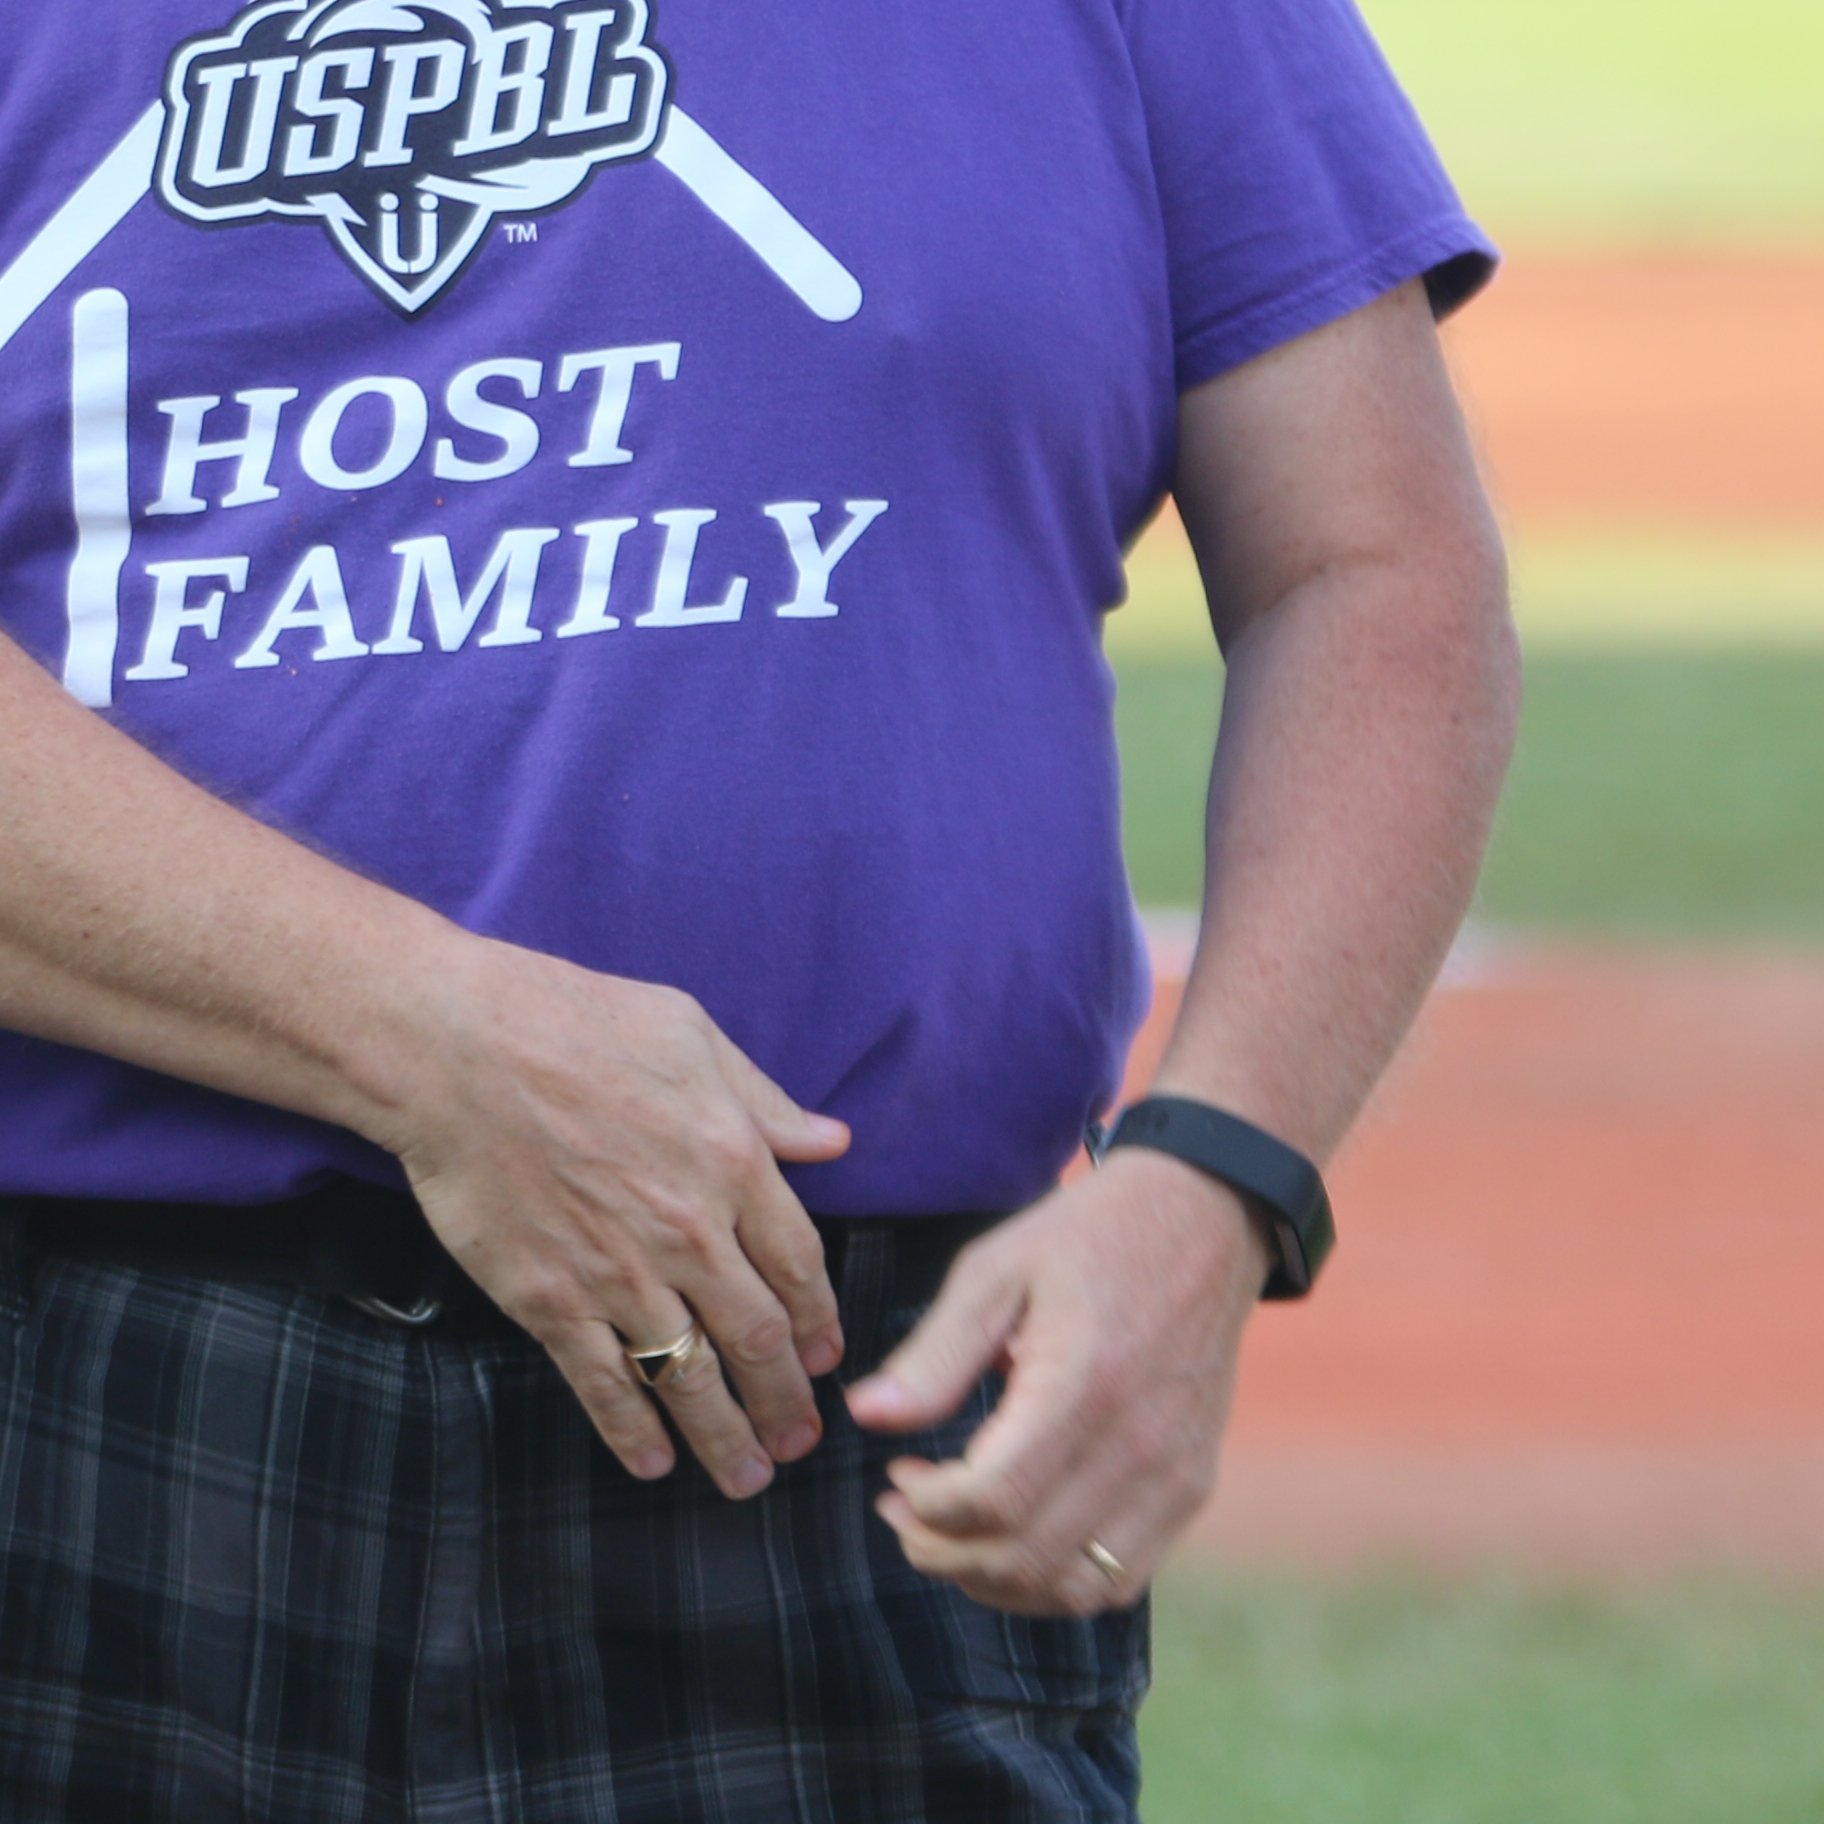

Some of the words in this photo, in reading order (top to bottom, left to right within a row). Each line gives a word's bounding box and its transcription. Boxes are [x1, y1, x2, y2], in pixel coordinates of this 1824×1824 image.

[190, 7, 636, 188] USPBL
[146, 343, 680, 514] HOST
[126, 500, 888, 680] FAMILY
